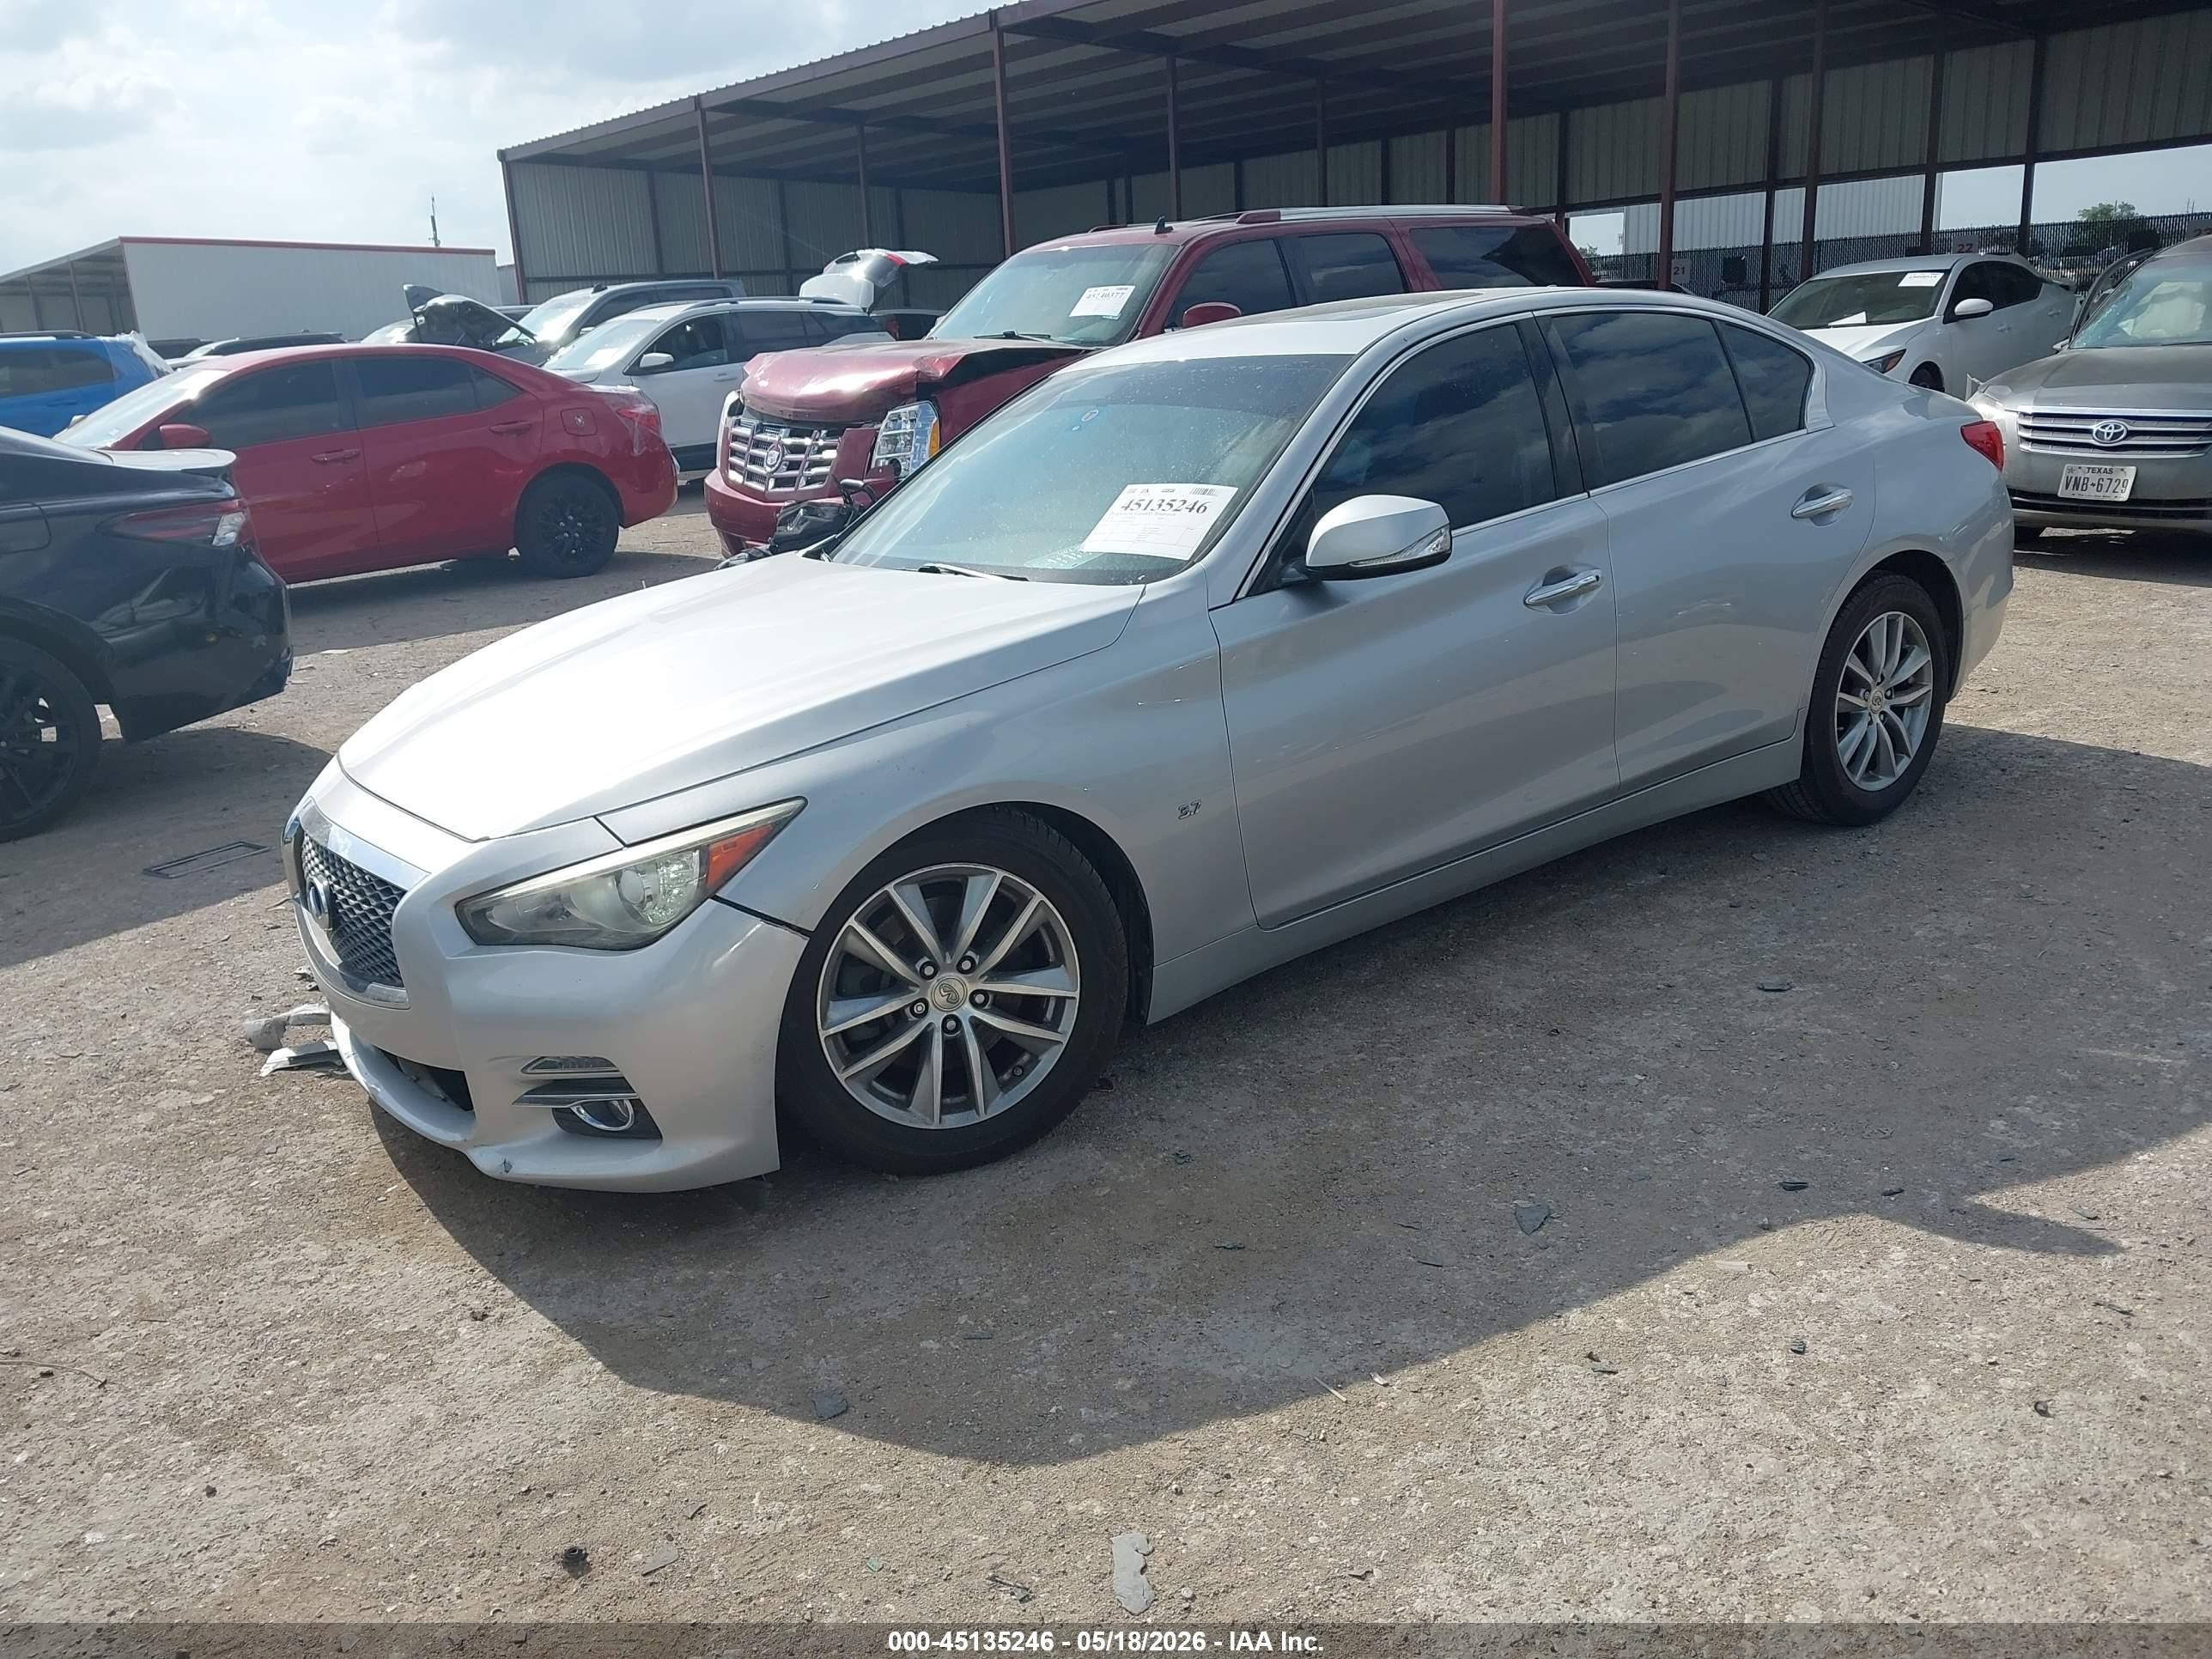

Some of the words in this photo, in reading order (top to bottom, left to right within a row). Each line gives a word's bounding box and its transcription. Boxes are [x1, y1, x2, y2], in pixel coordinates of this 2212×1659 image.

[1957, 243, 1973, 253] 22
[1673, 265, 1686, 276] 21
[2087, 466, 2114, 475] TEXAS
[1121, 498, 1212, 514] 45135246
